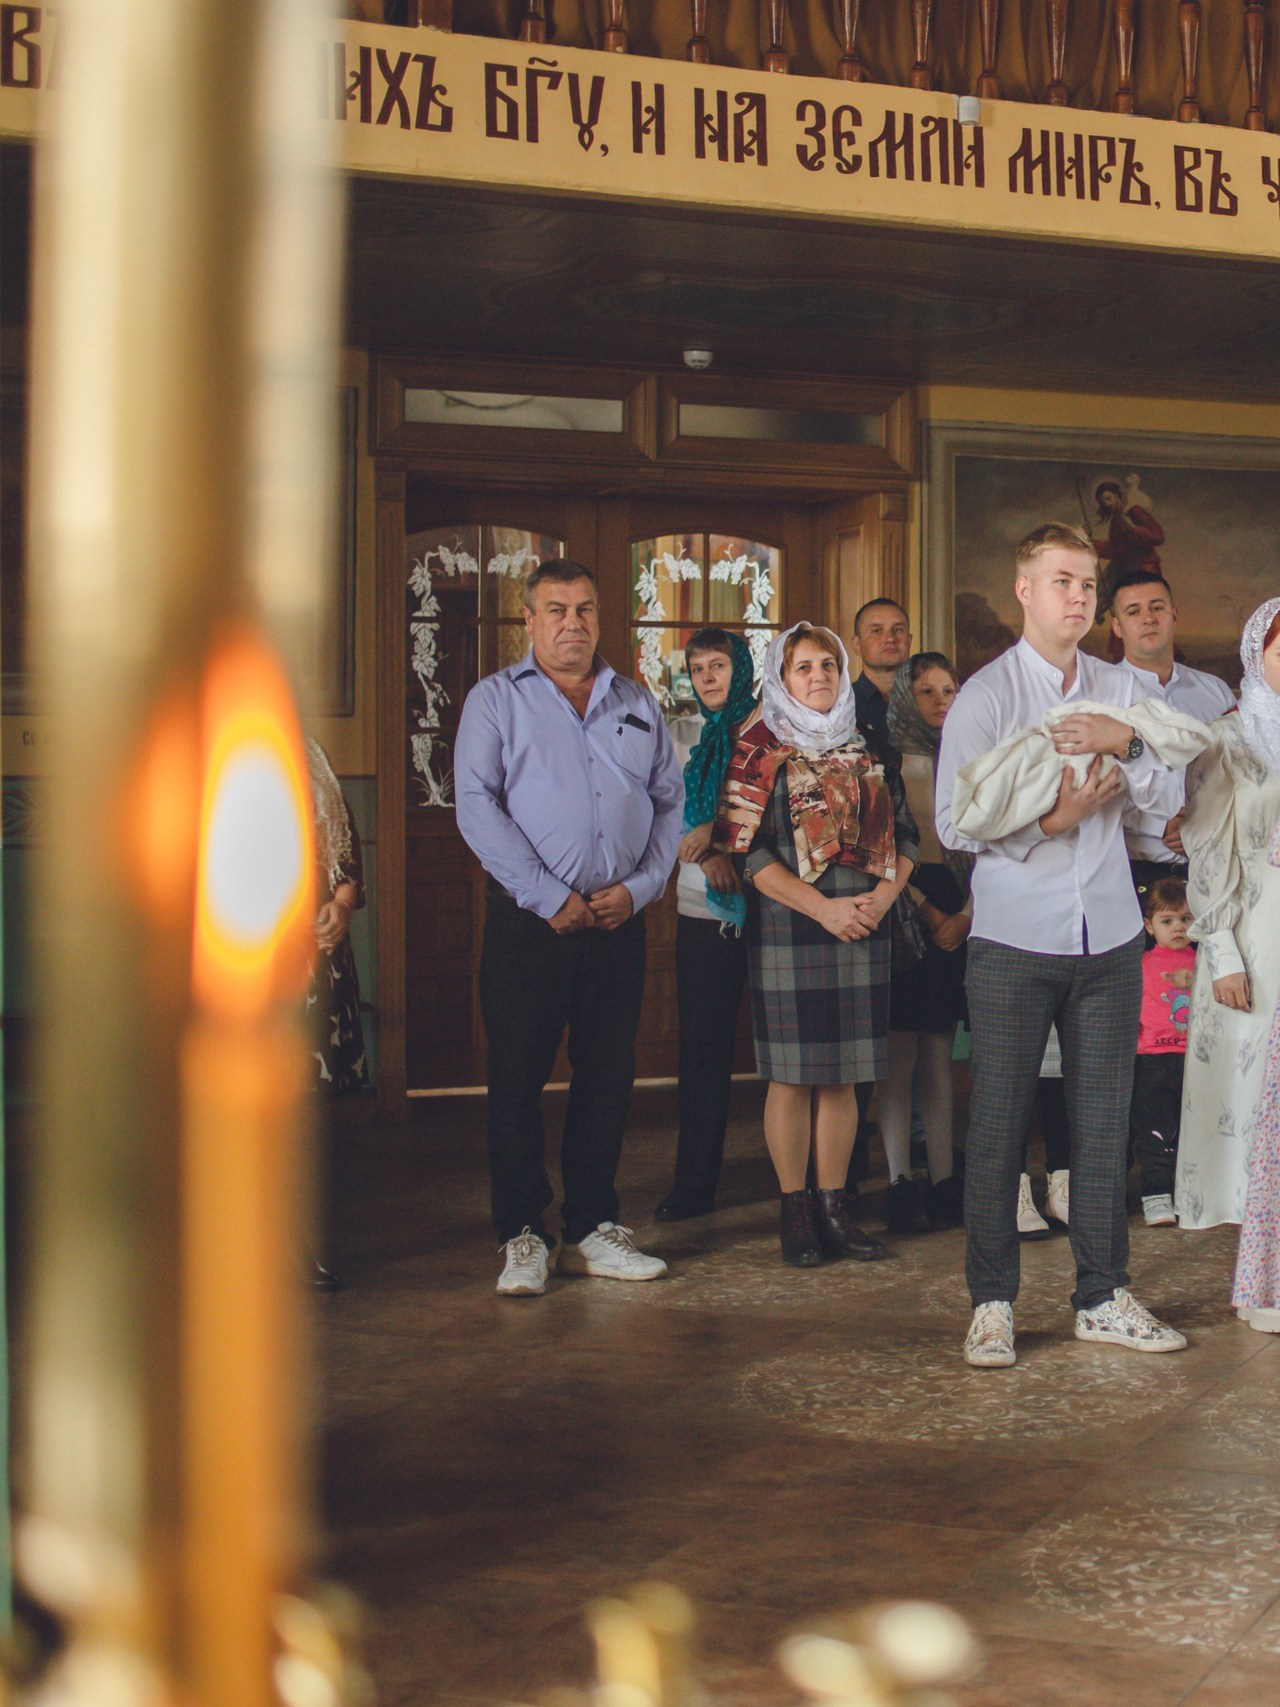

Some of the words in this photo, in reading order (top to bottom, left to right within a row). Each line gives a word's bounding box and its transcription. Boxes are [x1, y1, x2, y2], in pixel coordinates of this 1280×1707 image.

[631, 80, 666, 156] И
[694, 87, 769, 167] НА
[1007, 127, 1162, 210] МИРЪ,
[1173, 144, 1239, 217] ВЪ
